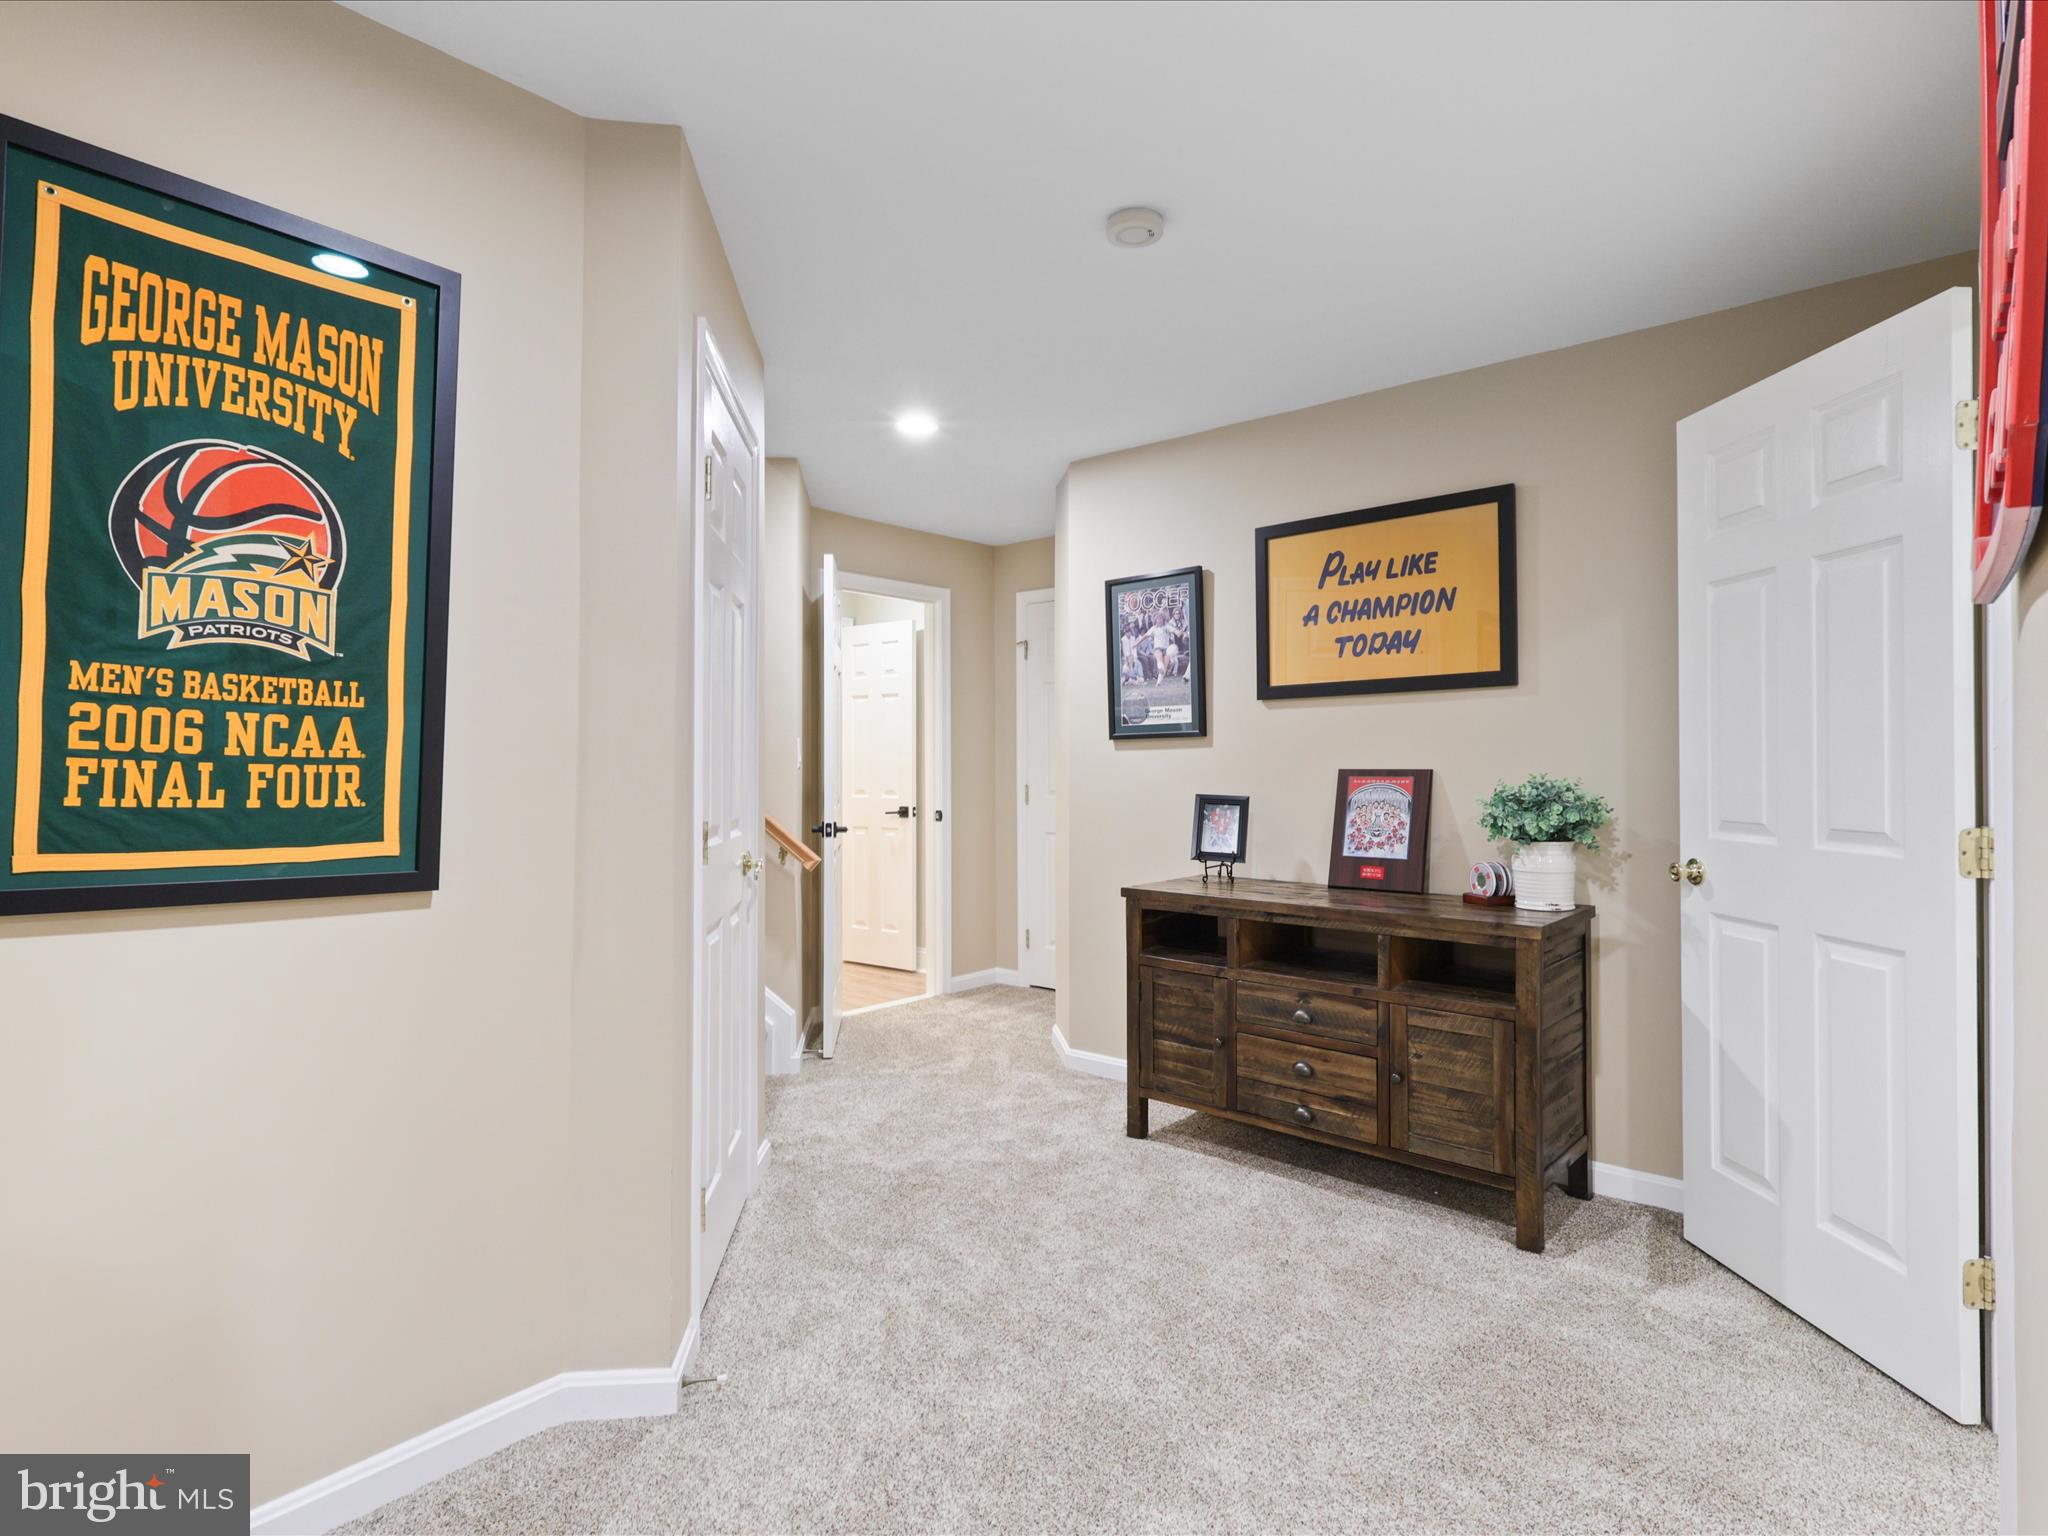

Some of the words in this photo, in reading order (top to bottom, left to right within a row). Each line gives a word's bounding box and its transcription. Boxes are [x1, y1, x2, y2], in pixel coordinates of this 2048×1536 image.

[81, 254, 243, 359] GEORGE
[253, 304, 384, 416] MASON
[112, 350, 358, 460] UNIVERSITY
[1318, 550, 1381, 590] PLAY
[1386, 551, 1439, 579] LIKE
[150, 575, 328, 642] MASON
[1302, 604, 1320, 627] A
[1326, 586, 1458, 624] CHAMPION
[188, 623, 293, 645] PATRIOTS
[1335, 629, 1422, 658] TODAY
[68, 660, 174, 698] MEN'S
[182, 669, 365, 708] BASKETBALL
[67, 701, 205, 755] 2006
[223, 711, 362, 759] NCAA
[63, 757, 225, 809] FINAL
[246, 763, 361, 809] FOUR
